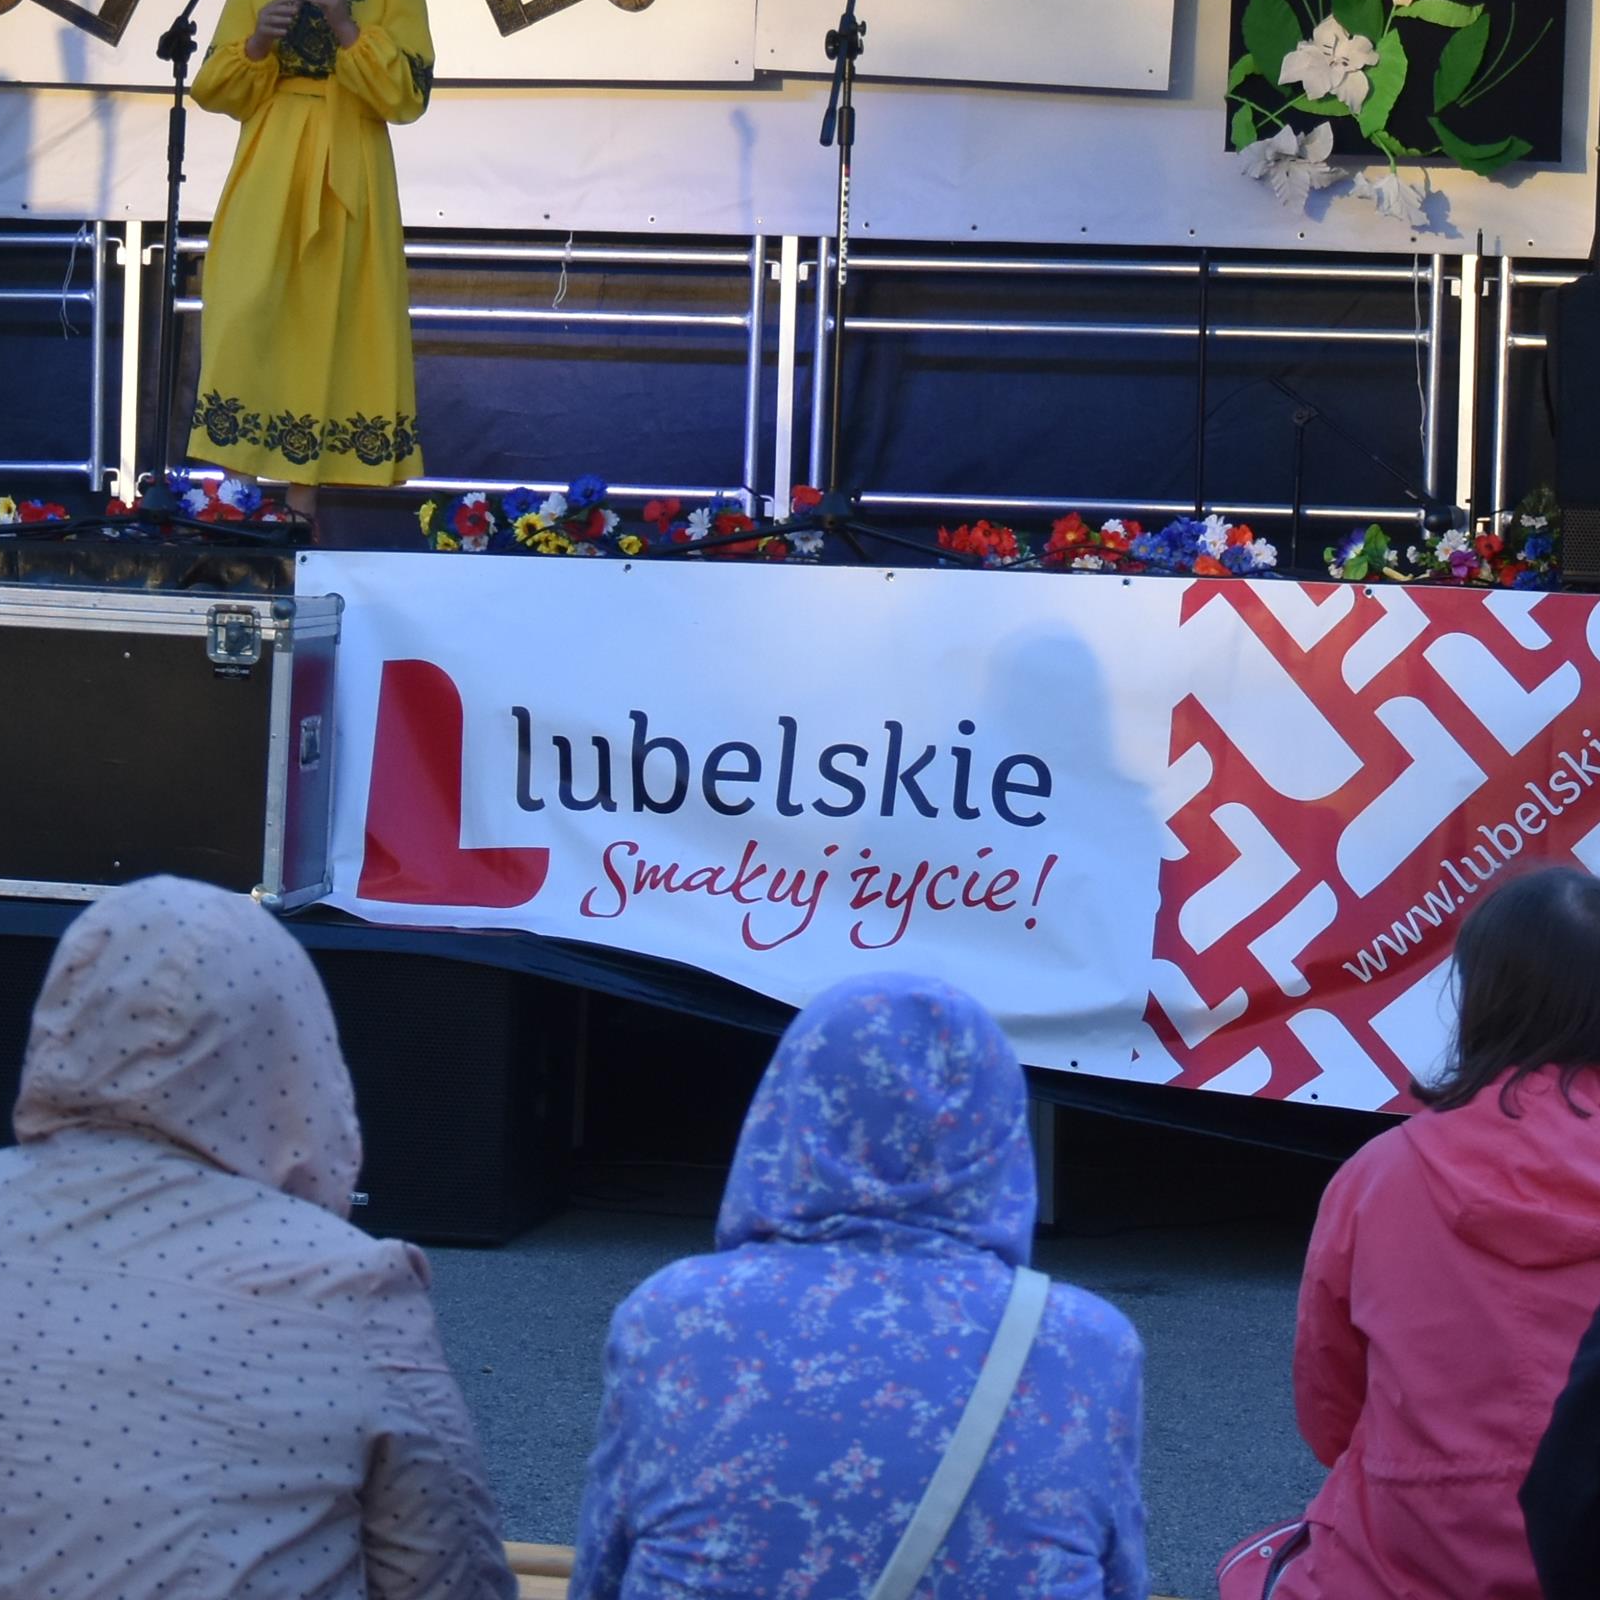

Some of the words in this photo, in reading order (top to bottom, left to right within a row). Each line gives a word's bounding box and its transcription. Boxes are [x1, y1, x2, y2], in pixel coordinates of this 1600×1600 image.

[511, 705, 1053, 828] lubelskie
[579, 838, 840, 951] Smakuj
[848, 846, 1059, 950] życie!
